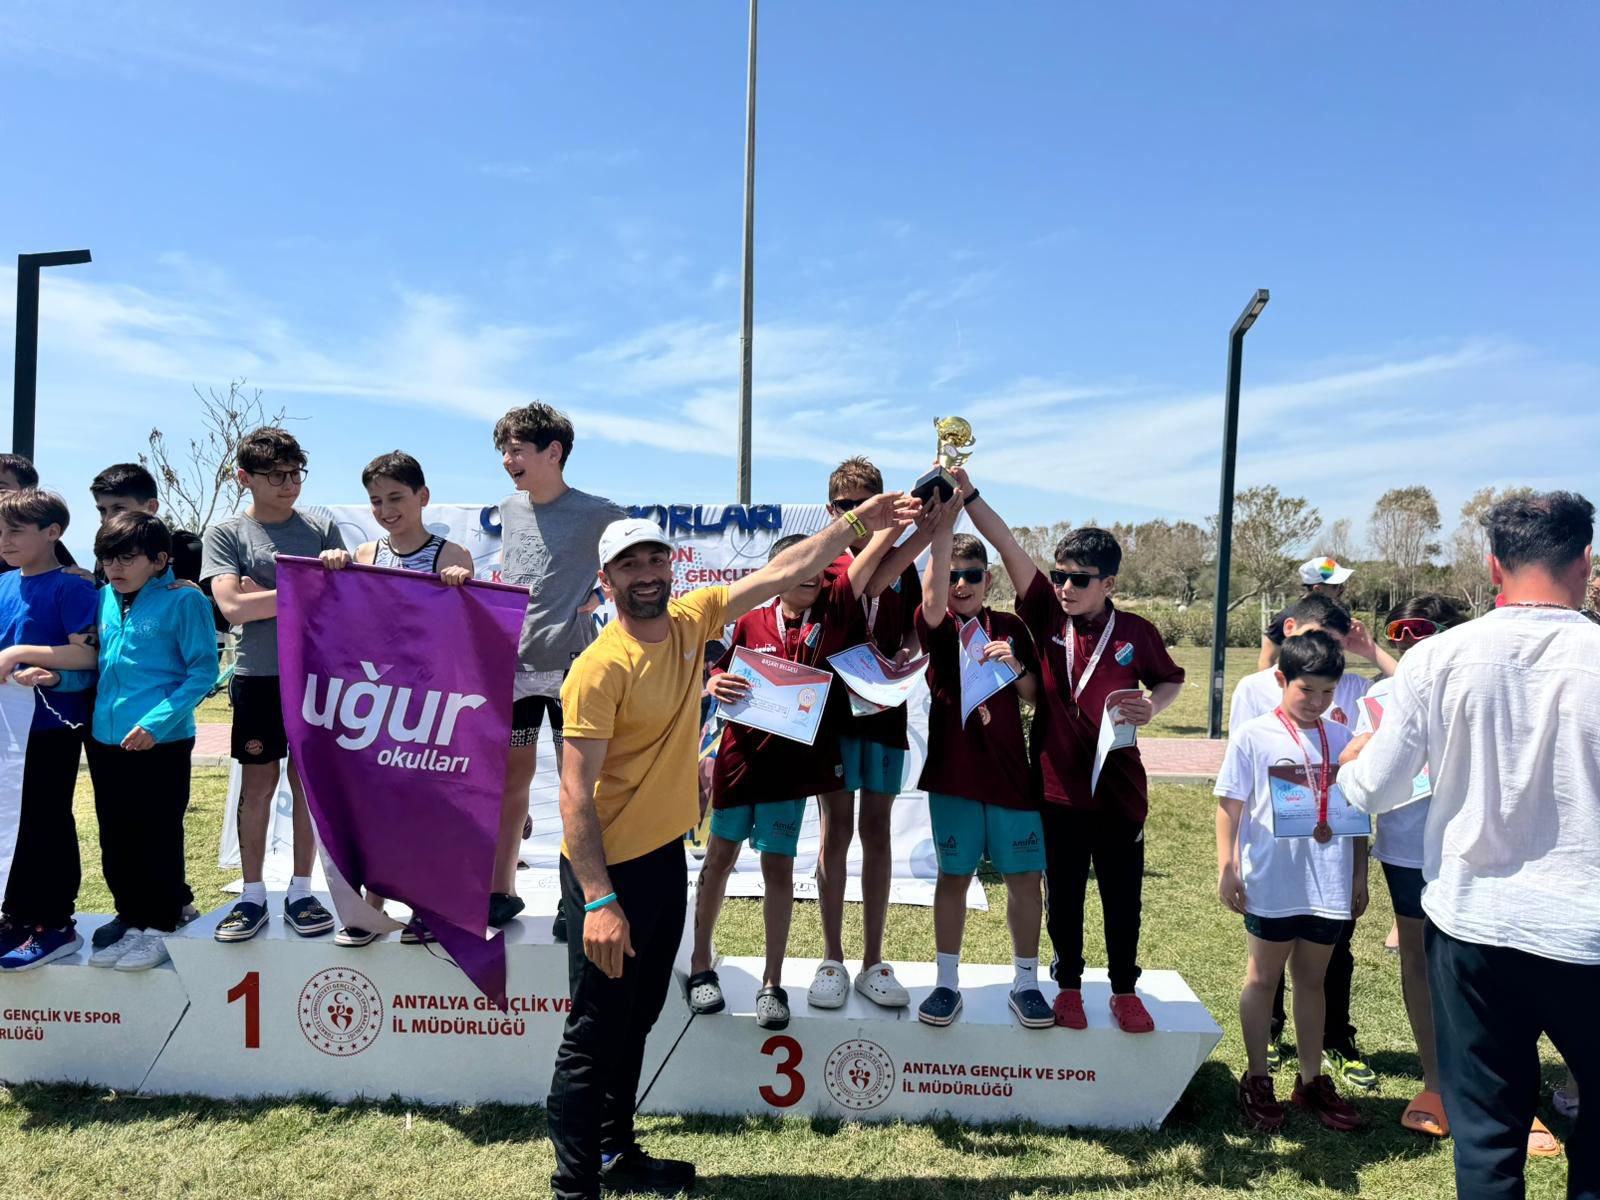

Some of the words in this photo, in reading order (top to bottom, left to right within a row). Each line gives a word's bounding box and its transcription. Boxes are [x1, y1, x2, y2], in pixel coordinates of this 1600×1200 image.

[685, 568, 761, 585] GENÇLE
[302, 661, 487, 750] uğur
[377, 746, 469, 773] okulları
[227, 972, 260, 1048] 1
[392, 995, 469, 1010] ANTALYA
[552, 999, 572, 1012] VE
[3, 1008, 61, 1025] GENÇLİK
[64, 1011, 81, 1022] VE
[84, 1012, 121, 1024] SPOR
[393, 1016, 407, 1033] İL
[412, 1017, 525, 1036] MÜDÜRLÜĞÜ
[759, 1035, 805, 1107] 3
[903, 1062, 966, 1076] ANTALYA
[970, 1064, 1032, 1081] GENÇLİK
[1036, 1068, 1054, 1080] VE
[1057, 1069, 1096, 1082] SPOR
[903, 1079, 915, 1093] İL
[918, 1080, 1013, 1097] MÜDÜRLÜĞÜ
